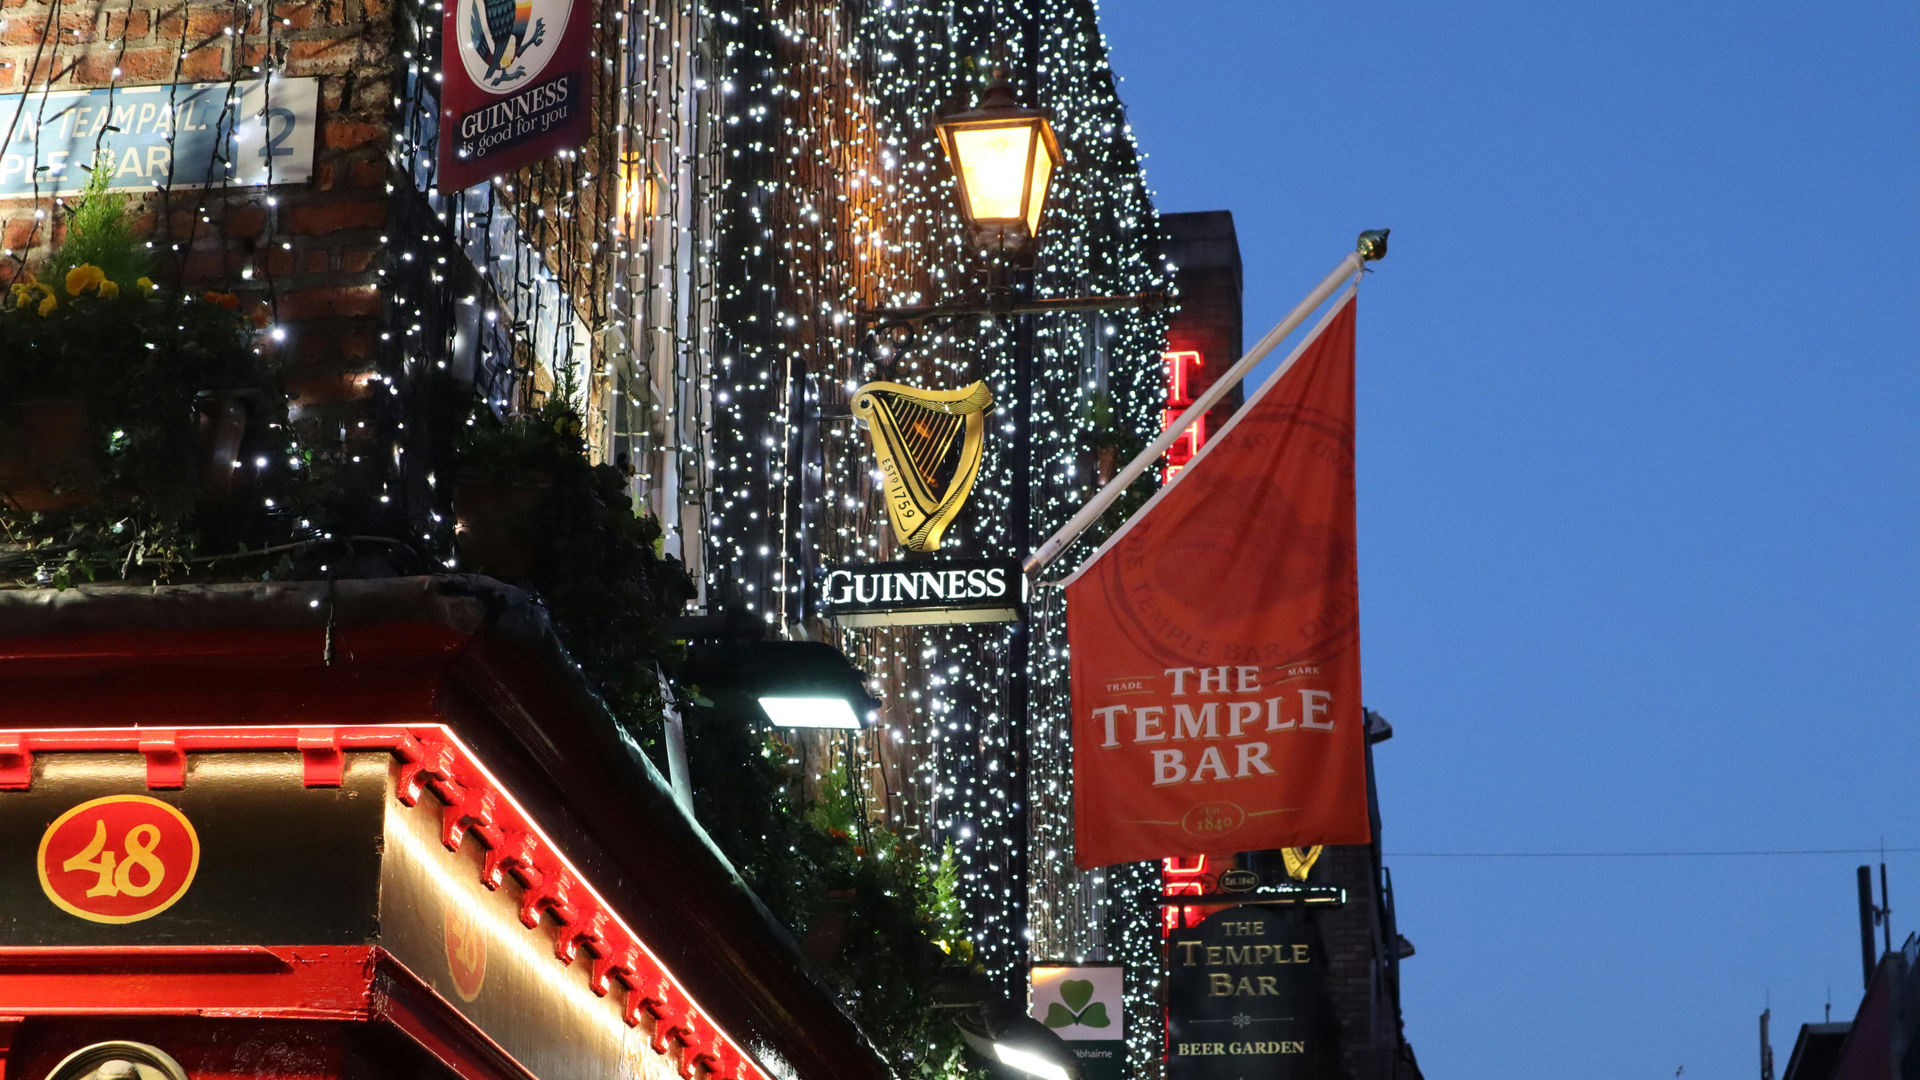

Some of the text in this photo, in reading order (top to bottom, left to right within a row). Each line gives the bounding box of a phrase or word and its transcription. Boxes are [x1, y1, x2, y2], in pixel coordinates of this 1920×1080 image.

[462, 76, 568, 138] GUINNESS
[257, 107, 297, 157] 2
[462, 105, 568, 157] is good for you
[89, 146, 172, 180] BAR
[891, 485, 915, 518] 1759
[822, 568, 1006, 604] GUINNESS
[1106, 681, 1143, 692] TRADE
[1164, 665, 1262, 696] THE
[1287, 665, 1320, 676] MARK
[1091, 688, 1336, 749] TEMPLE
[1151, 741, 1278, 788] BAR
[1197, 816, 1232, 831] 1840
[63, 819, 165, 898] 48
[1222, 921, 1265, 936] THE
[1176, 940, 1311, 967] TEMPLE
[1208, 973, 1281, 997] BAR
[1178, 1041, 1305, 1056] BEER GARDEN
